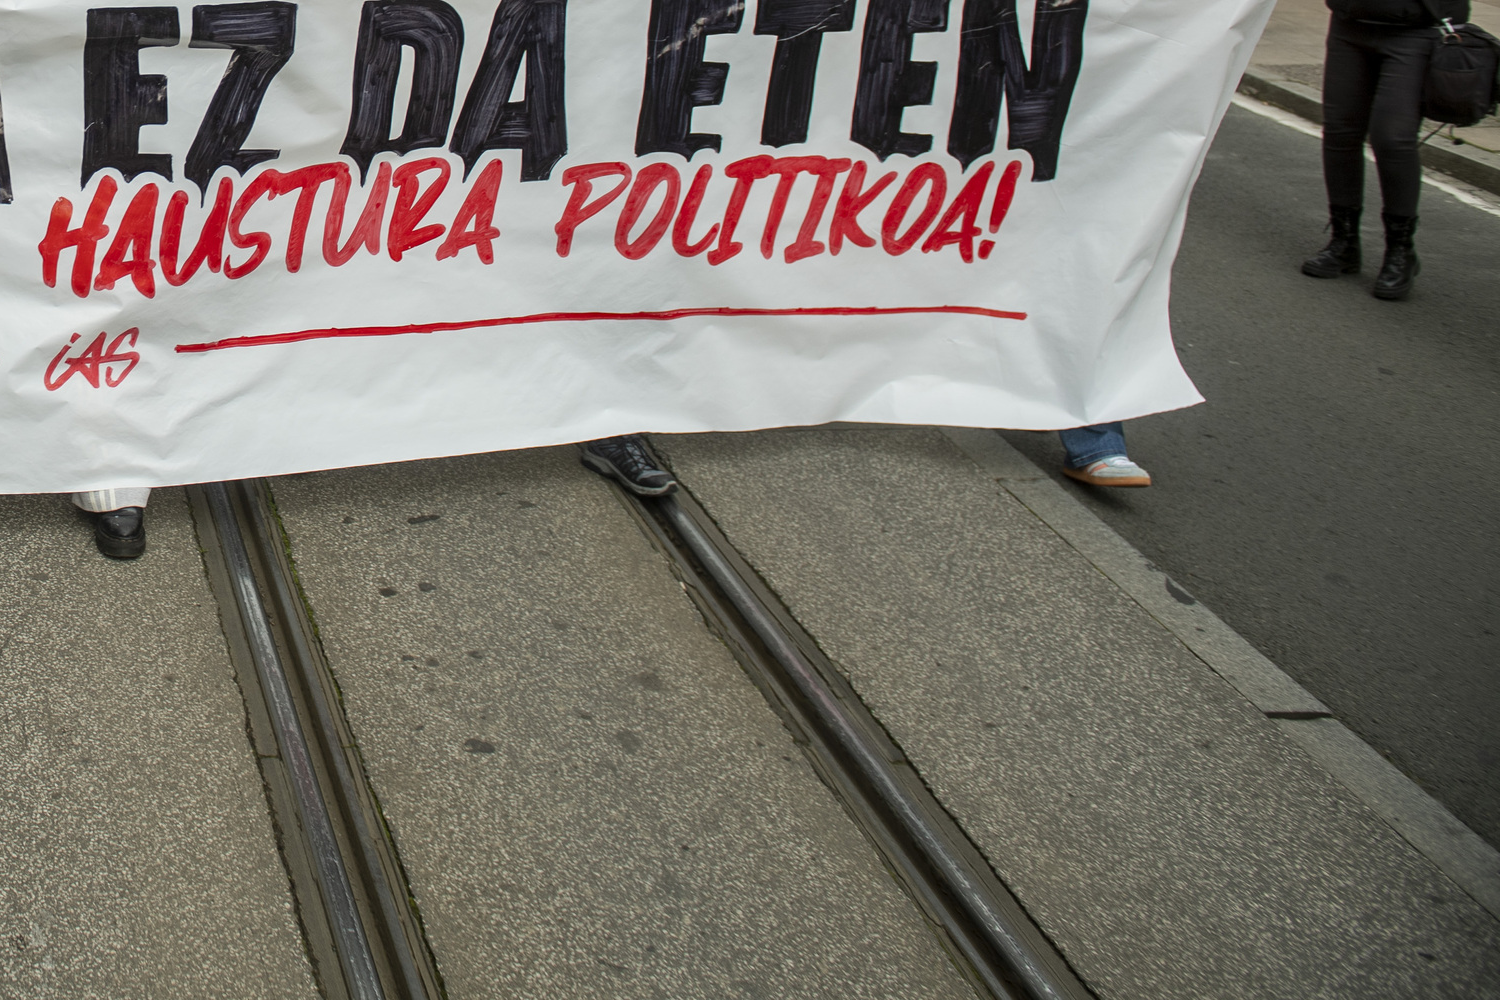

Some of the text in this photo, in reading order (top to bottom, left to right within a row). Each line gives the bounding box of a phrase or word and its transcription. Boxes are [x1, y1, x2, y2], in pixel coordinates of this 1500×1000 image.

[81, 1, 298, 208] EZ
[37, 157, 502, 299] HAUSTURA
[554, 154, 1023, 267] POLITIKOA!
